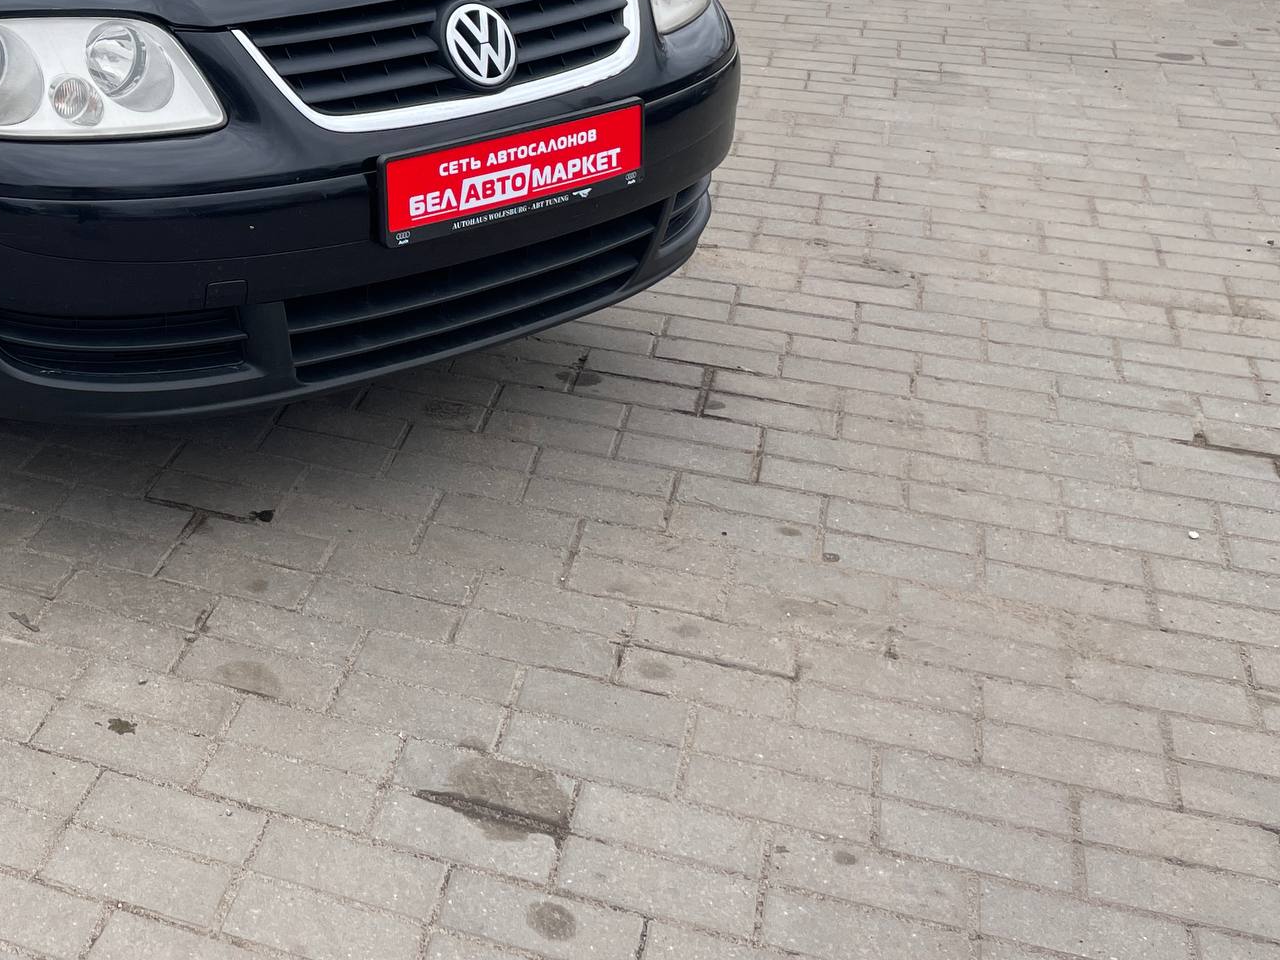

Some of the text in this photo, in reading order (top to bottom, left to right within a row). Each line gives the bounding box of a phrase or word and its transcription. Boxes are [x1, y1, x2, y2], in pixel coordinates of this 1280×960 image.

[438, 128, 597, 177] СЕТЬ АВТОСАЛОНОВ
[452, 214, 488, 230] AUTOHAUS
[488, 205, 528, 221] WOLFSBURG
[545, 195, 570, 207] TUNING
